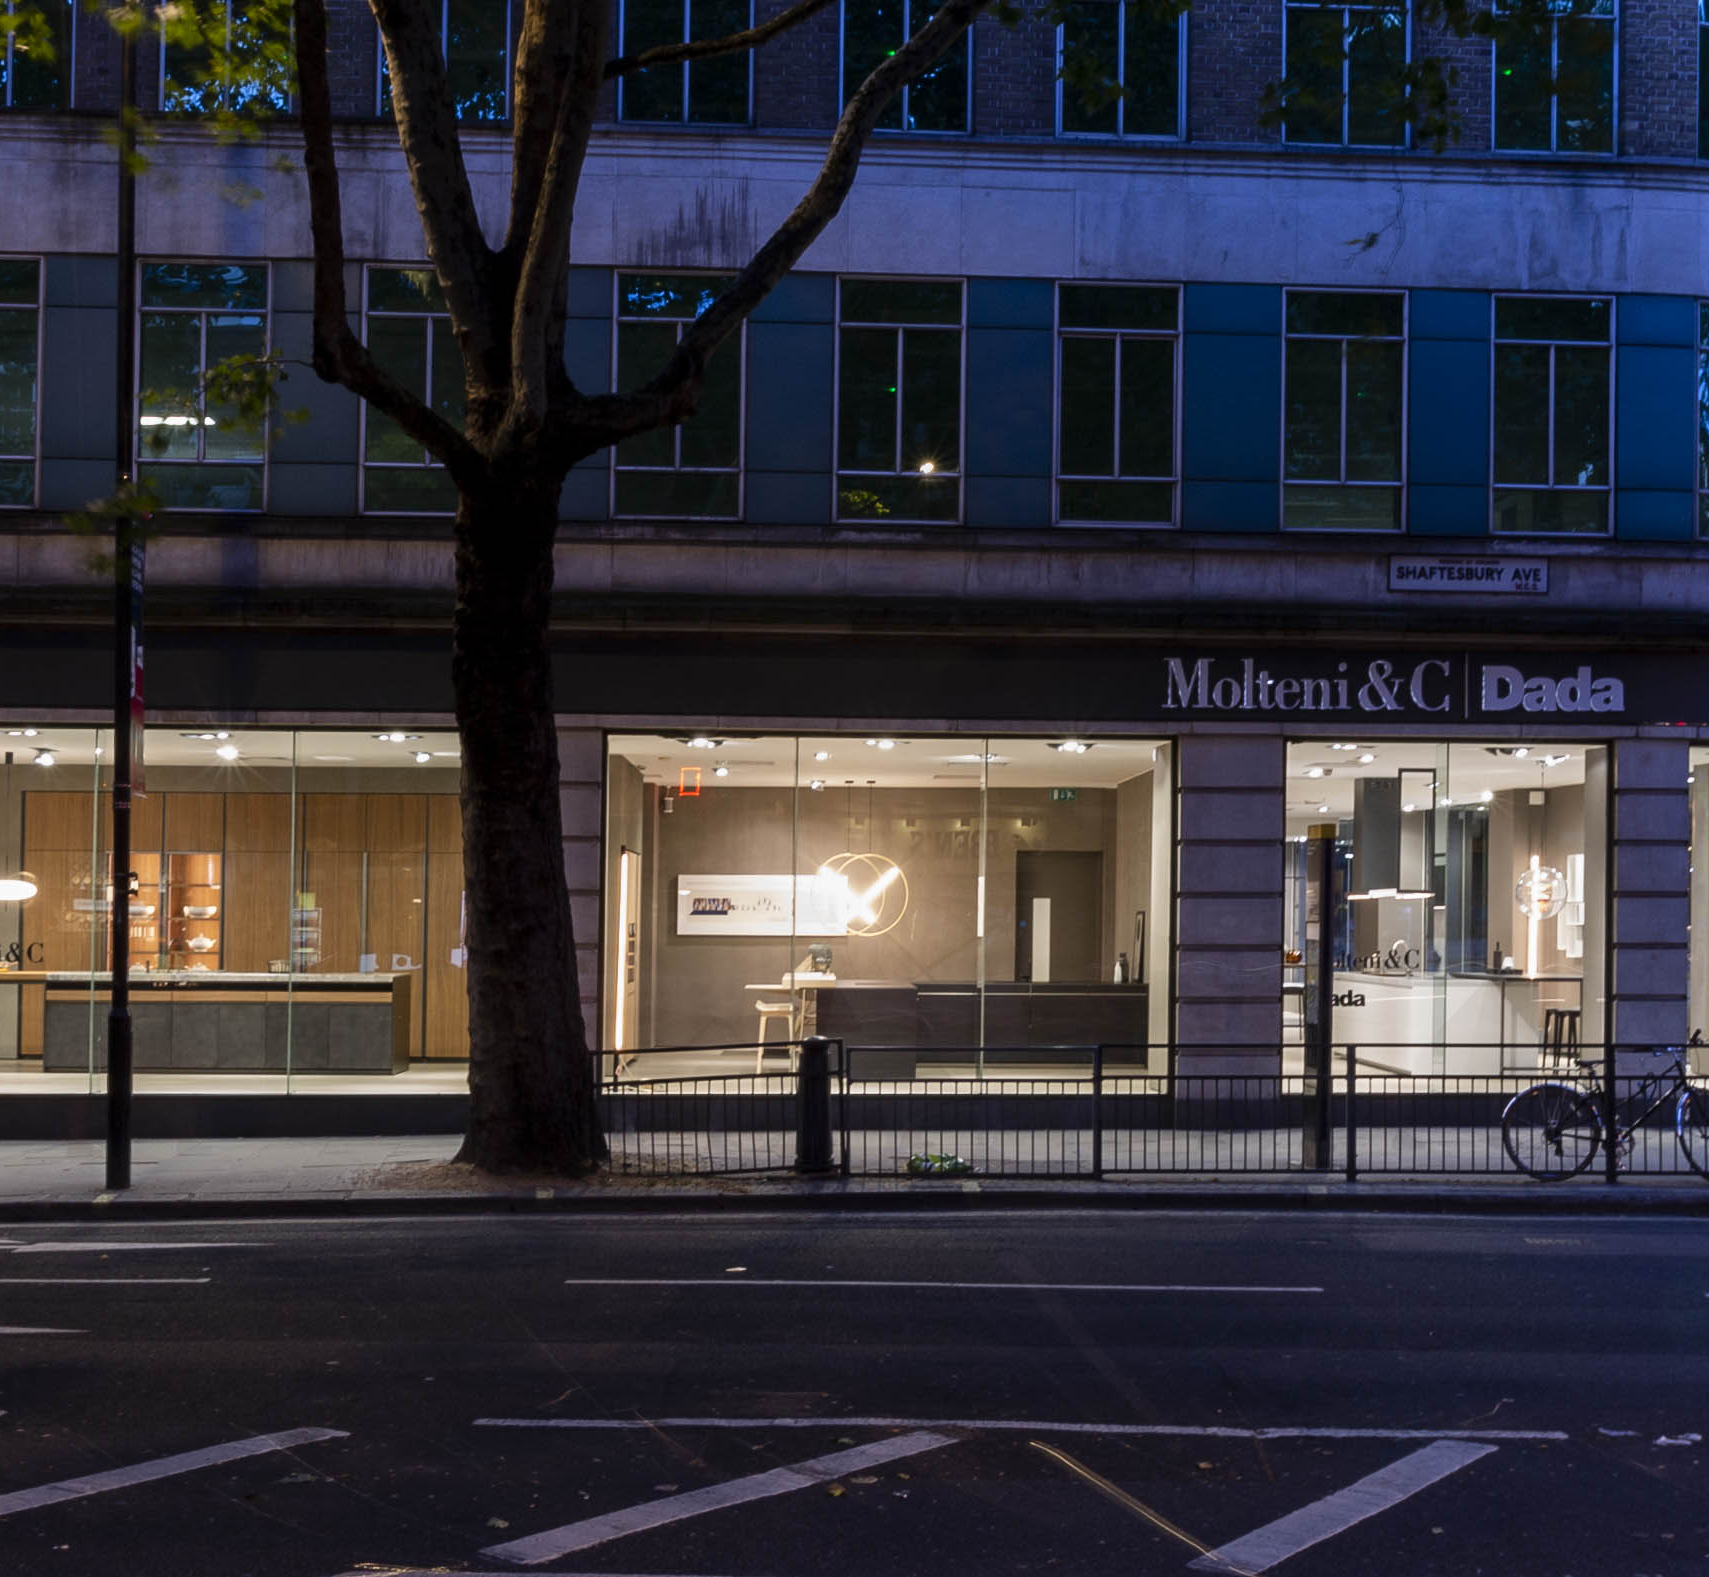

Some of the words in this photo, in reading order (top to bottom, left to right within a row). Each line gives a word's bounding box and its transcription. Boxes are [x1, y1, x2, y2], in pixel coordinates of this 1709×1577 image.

[1395, 565, 1505, 582] SHAFTESBURY
[1511, 567, 1541, 583] AVE
[1161, 657, 1452, 714] Molteni&C
[1481, 663, 1626, 714] Dada
[1331, 989, 1366, 1008] ada
